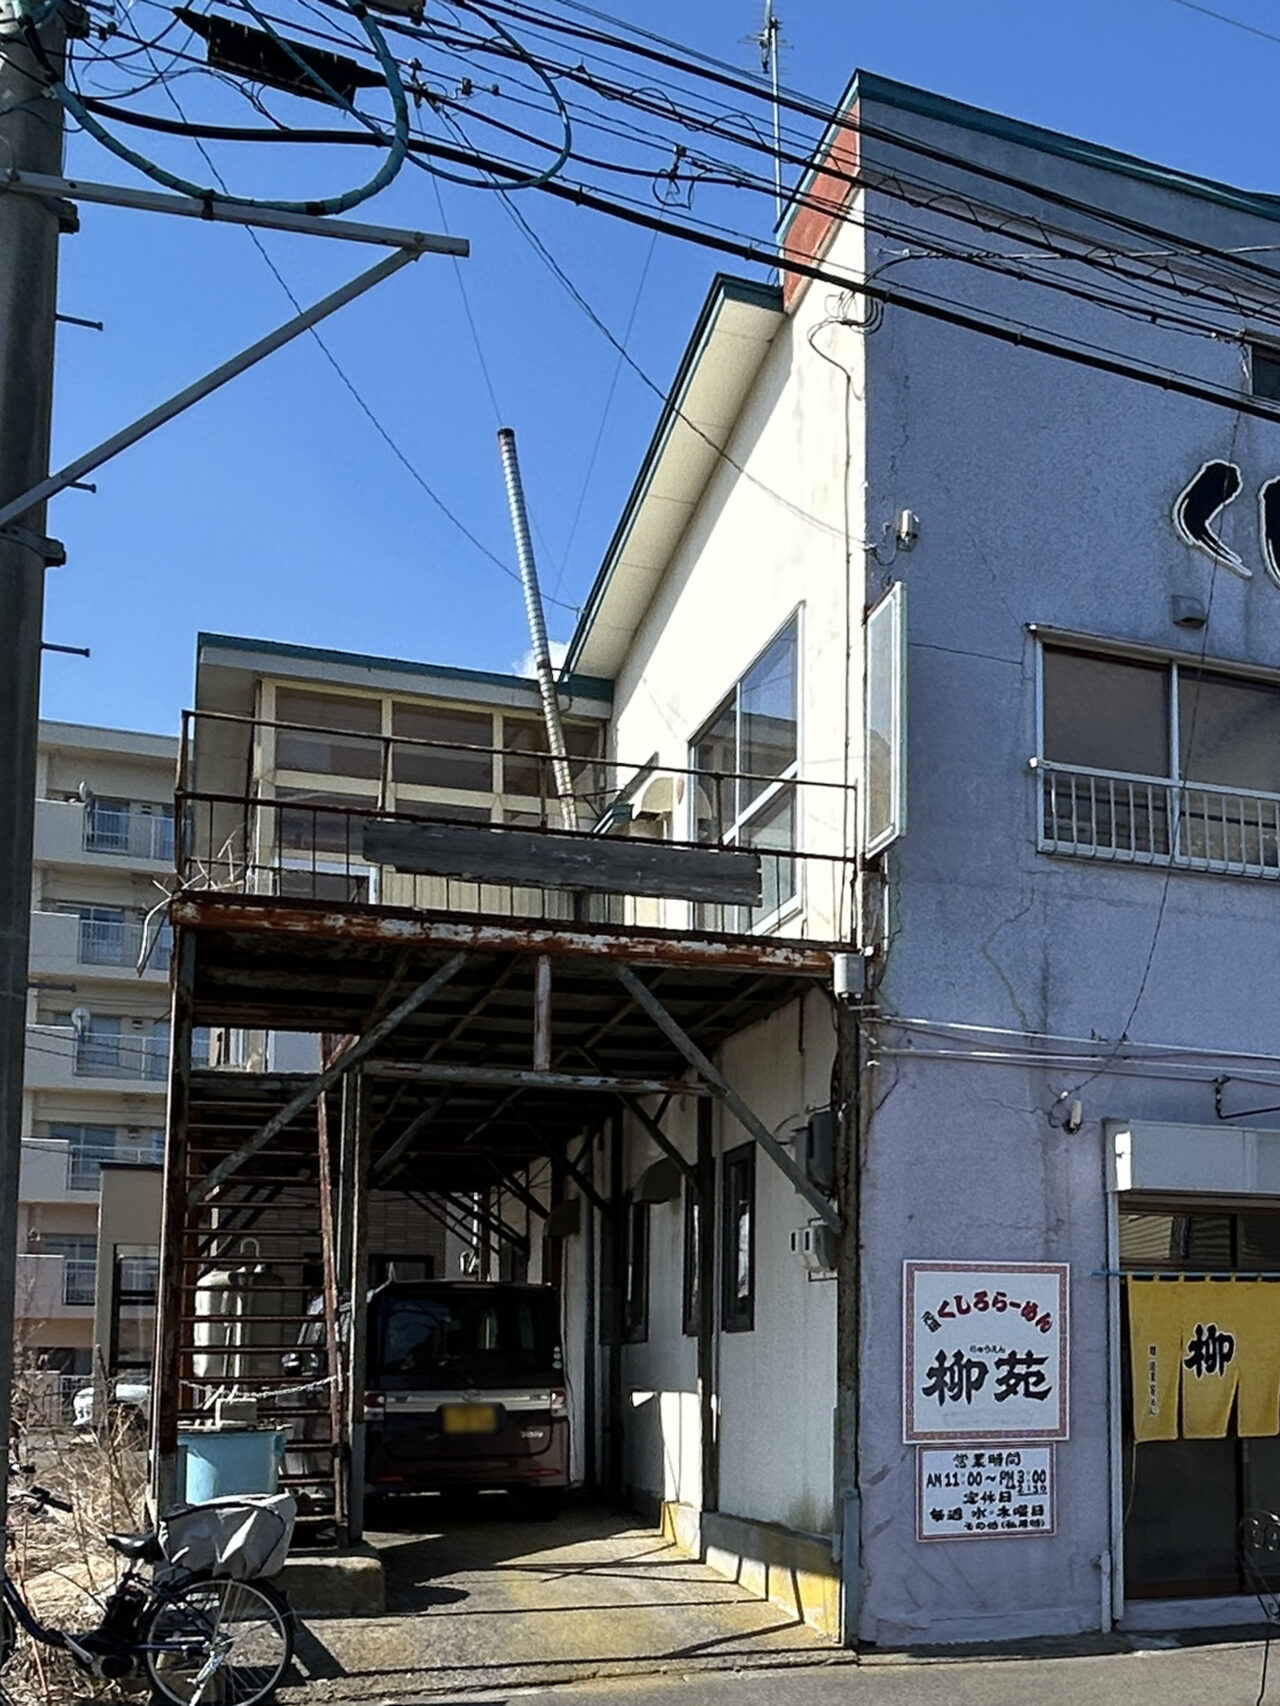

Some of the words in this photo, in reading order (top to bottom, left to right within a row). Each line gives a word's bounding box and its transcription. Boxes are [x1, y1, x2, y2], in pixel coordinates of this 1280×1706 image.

[937, 1290, 1053, 1333] くしろらーめん
[922, 1349, 1053, 1406] 柳苑
[952, 1451, 1021, 1469] 営業時間
[963, 1490, 1012, 1505] 定休日
